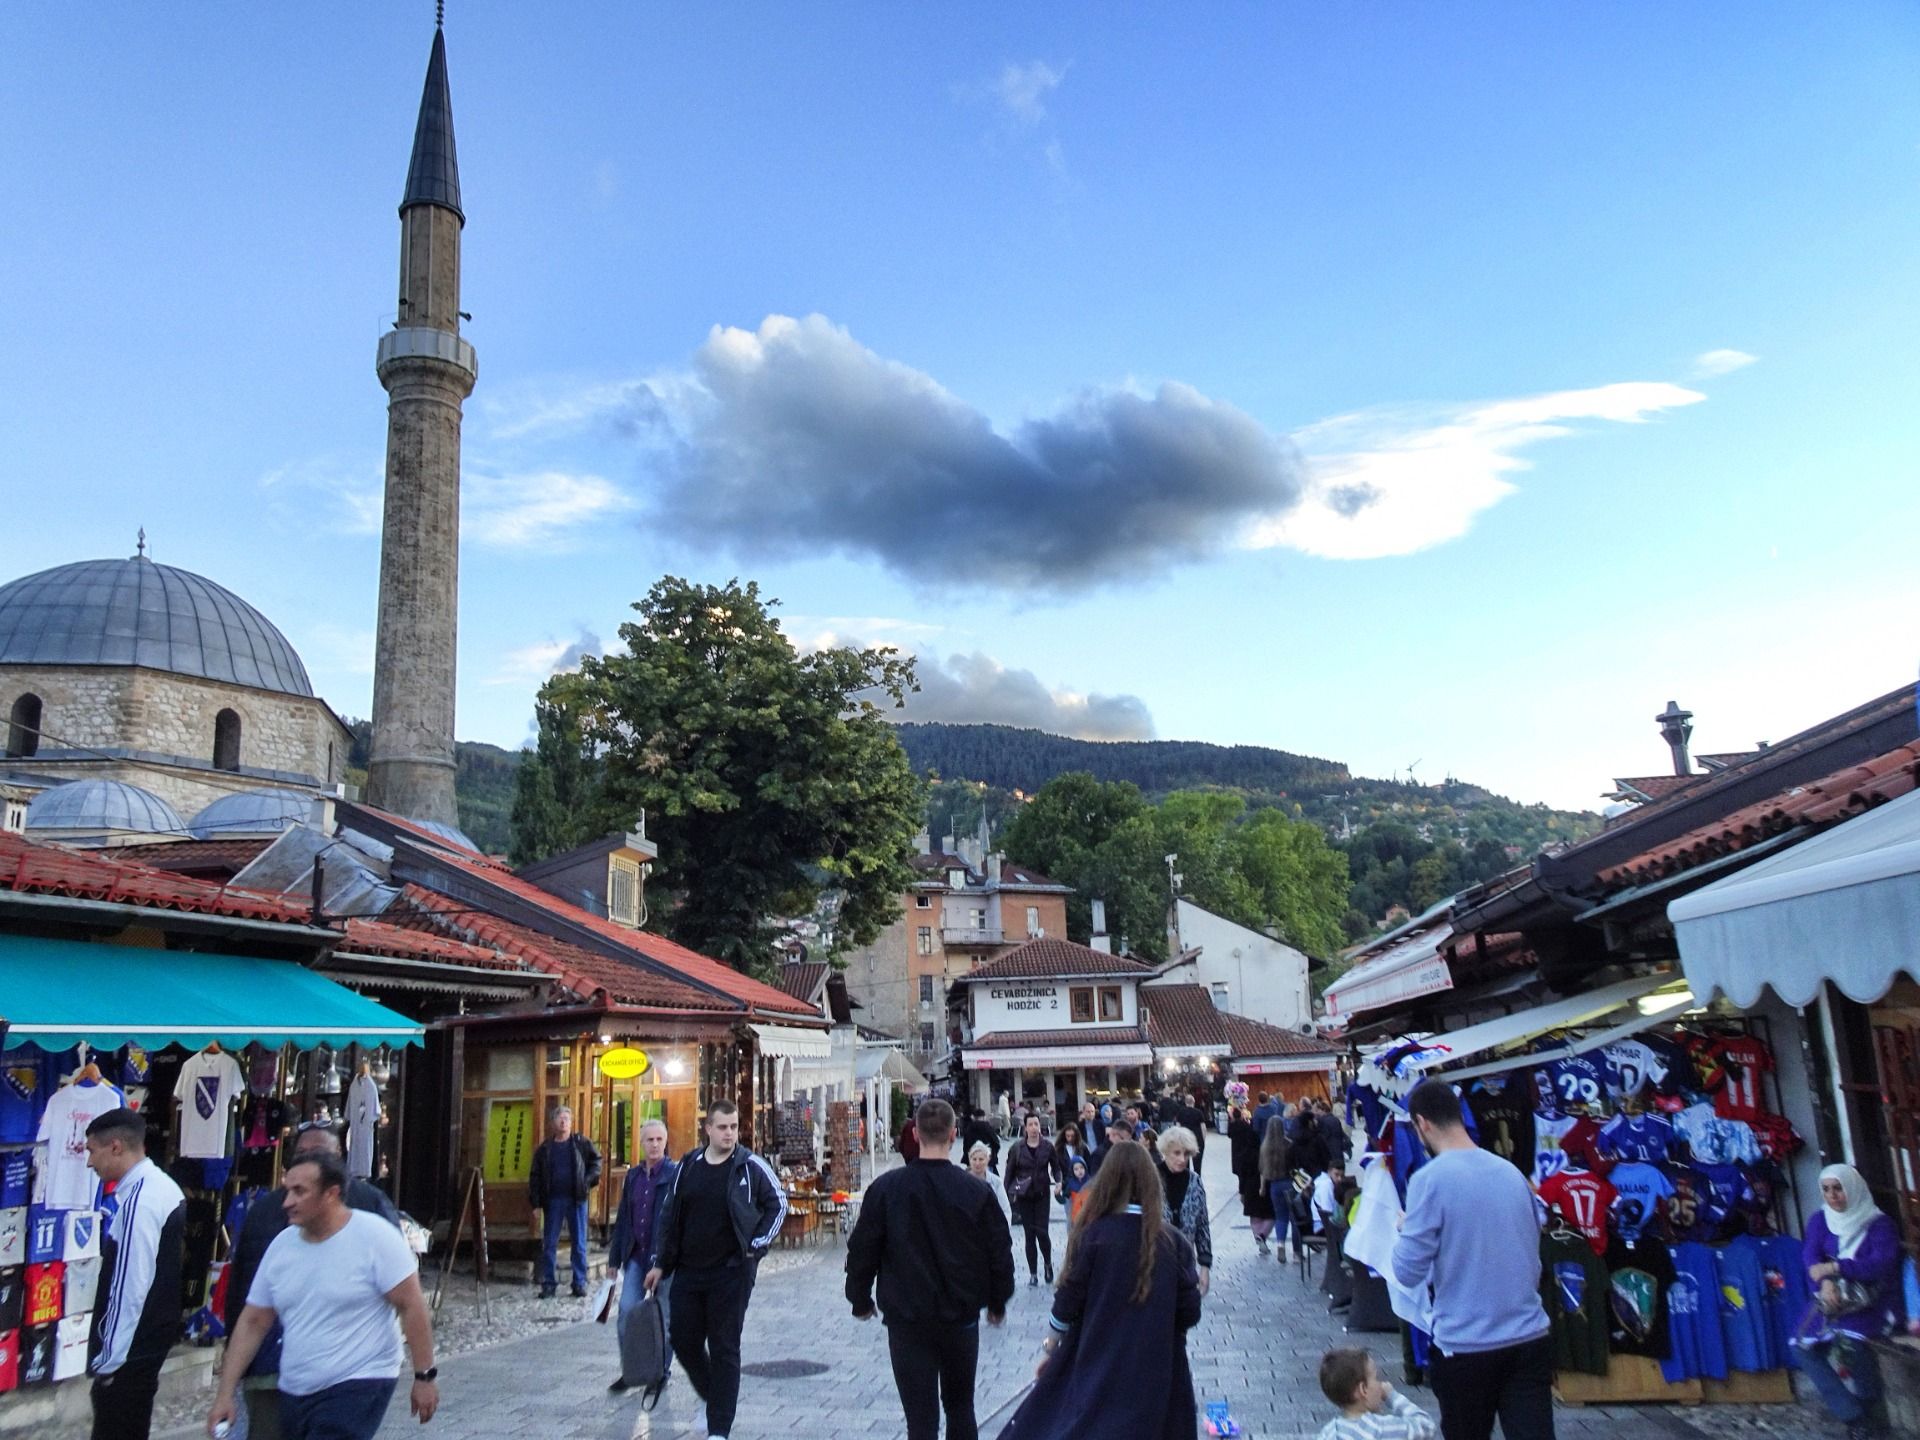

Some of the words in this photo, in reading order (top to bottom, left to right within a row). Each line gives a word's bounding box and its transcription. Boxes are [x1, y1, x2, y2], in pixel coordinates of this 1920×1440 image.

[1050, 999, 1058, 1009] 2
[602, 1059, 627, 1067] EXCHANGE
[628, 1058, 645, 1066] OFFICE
[1636, 1144, 1650, 1161] 11
[1569, 1189, 1596, 1226] 17
[1668, 1197, 1697, 1227] 25
[36, 1224, 55, 1249] 11
